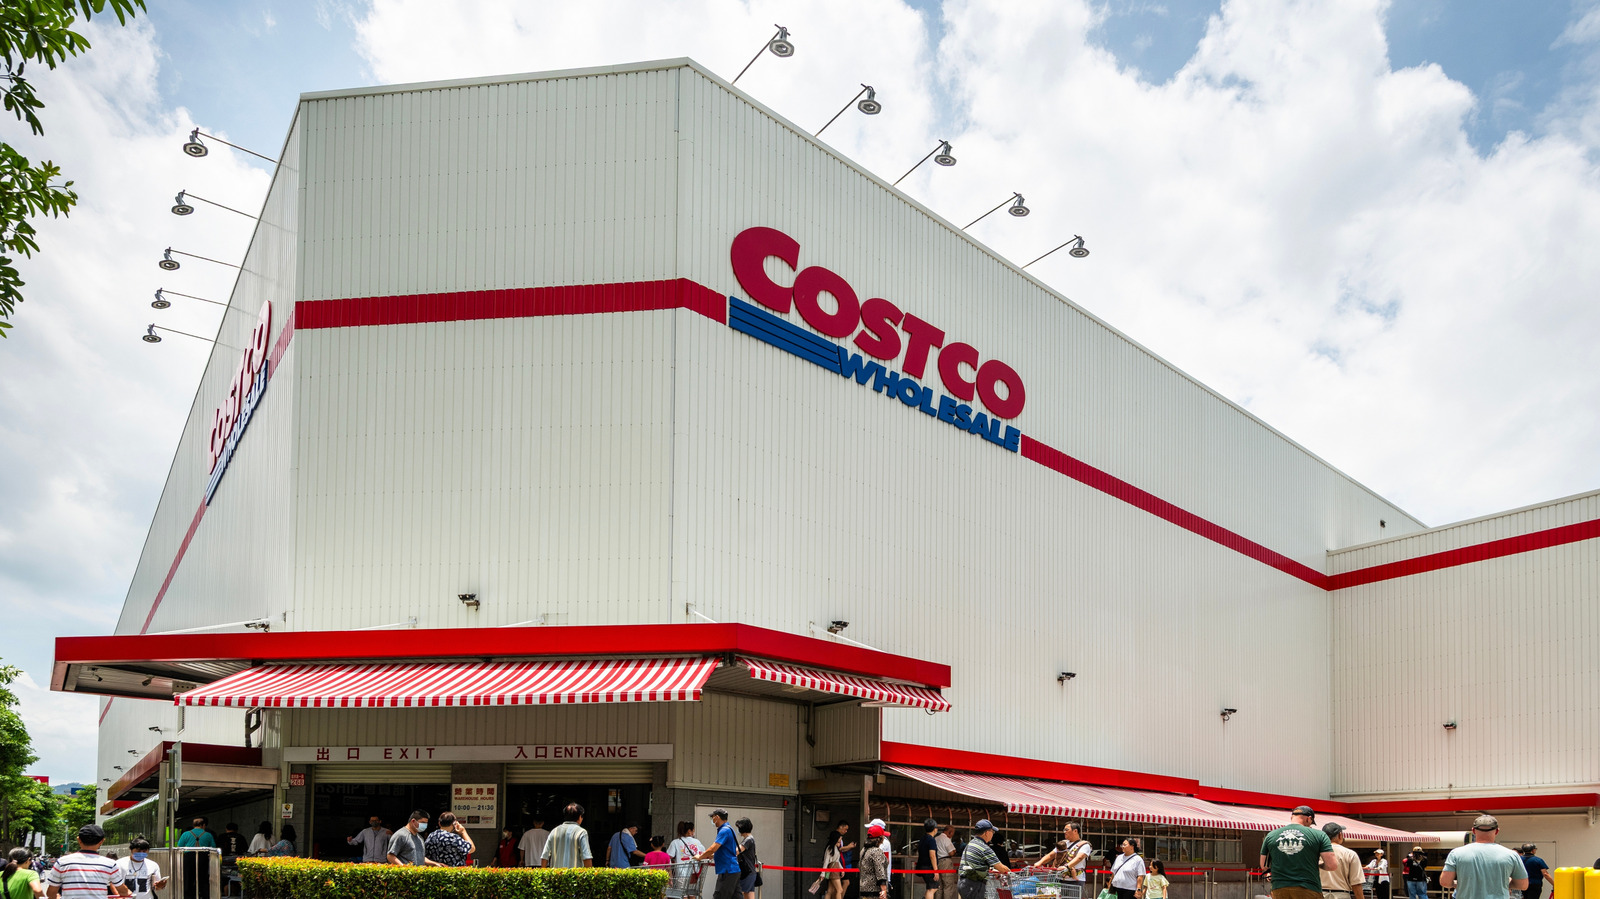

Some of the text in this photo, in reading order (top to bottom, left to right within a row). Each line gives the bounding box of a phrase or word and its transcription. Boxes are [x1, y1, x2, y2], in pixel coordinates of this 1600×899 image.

[730, 226, 1026, 420] COSTCO
[837, 345, 1021, 453] WHOLESALE
[316, 747, 435, 761] 出口 EXIT
[514, 746, 638, 759] 入口 ENTRANCE
